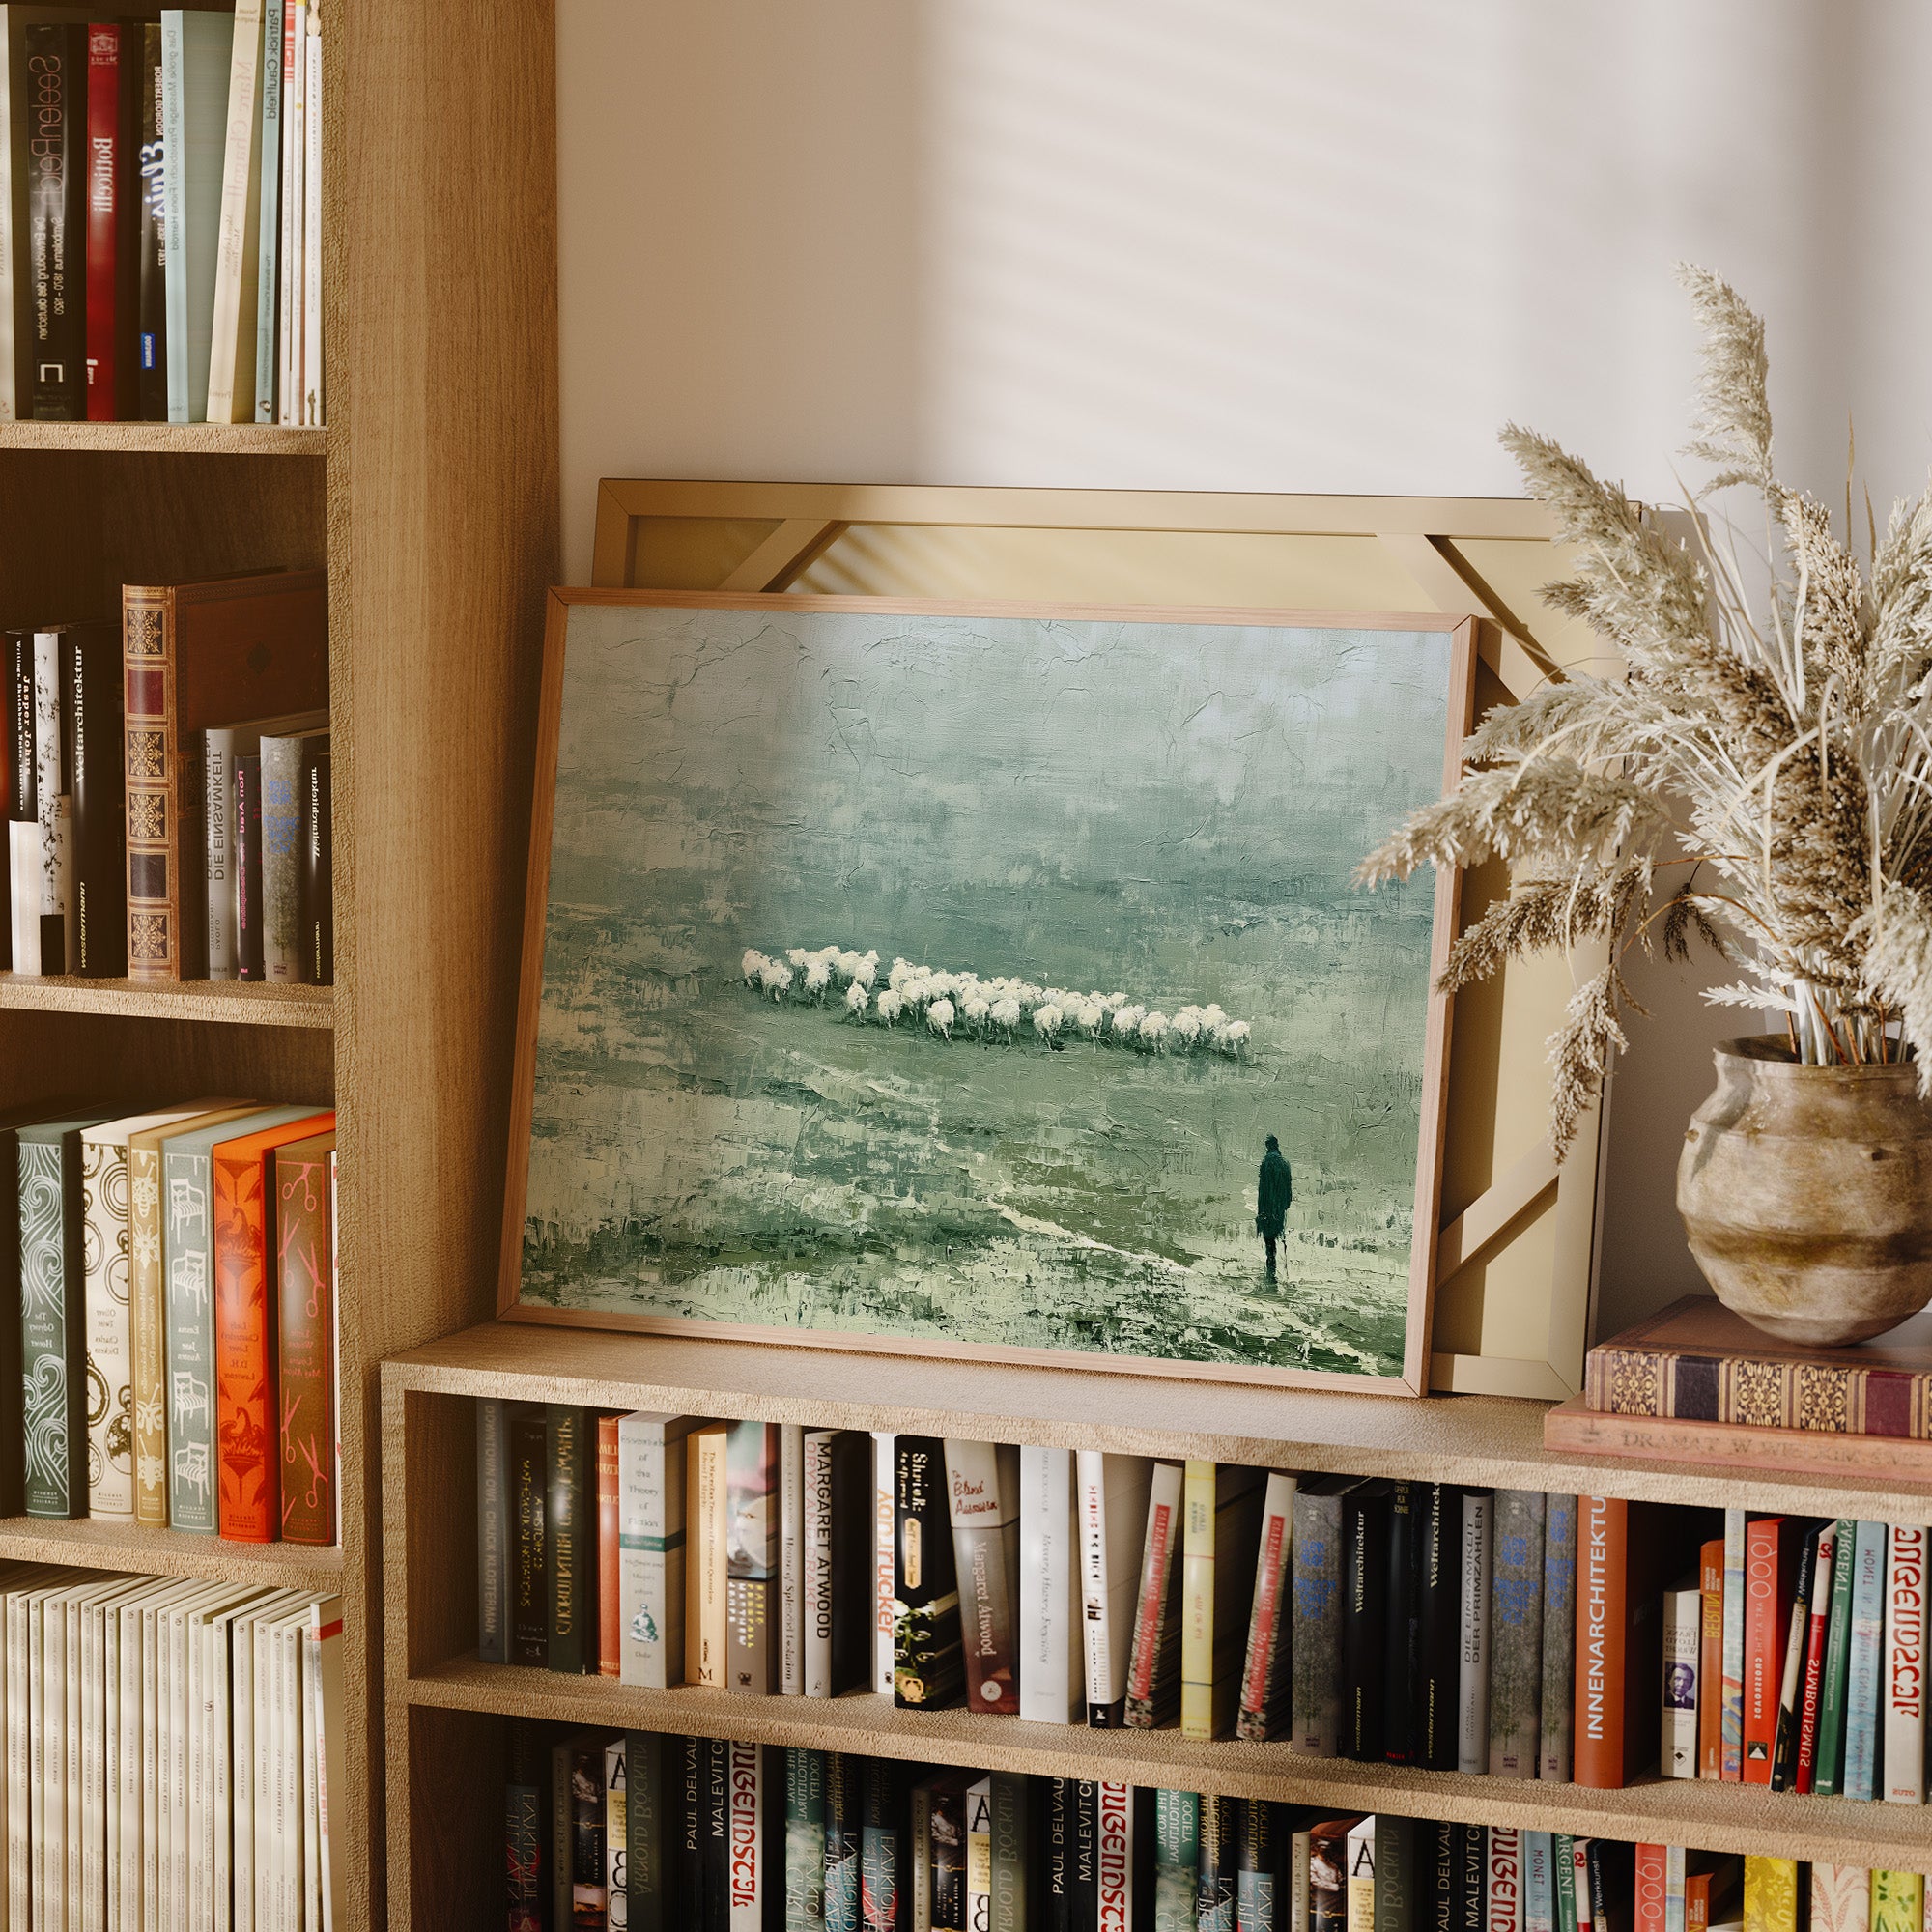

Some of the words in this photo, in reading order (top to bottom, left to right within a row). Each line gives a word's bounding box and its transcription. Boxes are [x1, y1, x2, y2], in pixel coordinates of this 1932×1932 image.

[22, 675, 32, 726] Jasper
[75, 646, 85, 784] Weltarchitektur
[23, 730, 33, 776] Johns
[485, 1406, 496, 1476] DOWNTOWN
[806, 1441, 816, 1492] ORYX
[1622, 1433, 1719, 1451] DRAMAT
[1734, 1439, 1752, 1453] W
[485, 1478, 496, 1504] OWL
[629, 1486, 659, 1497] Theory
[816, 1442, 831, 1551] MARGARET
[911, 1452, 929, 1512] Shriek:
[953, 1481, 983, 1495] Blind
[485, 1511, 496, 1550] CHUCK
[628, 1519, 659, 1529] Fiction
[806, 1497, 816, 1539] AND
[1430, 1482, 1441, 1588] Weltarchitekt
[806, 1546, 817, 1612] CRAKE
[973, 1540, 991, 1600] Margaret
[1355, 1511, 1366, 1613] Weltarchitektur
[1464, 1520, 1474, 1629] EINSAMKEIT
[1472, 1505, 1483, 1621] PRIMZAHLEN
[485, 1555, 496, 1633] KLOSTERMAN
[816, 1557, 831, 1639] ATWOOD
[1587, 1495, 1607, 1740] INNENARCHITEKTU
[978, 1605, 997, 1656] Atwood
[1472, 1627, 1482, 1663] DER
[1427, 1678, 1435, 1759] westermann
[685, 1736, 697, 1803] DELVAU
[685, 1811, 697, 1851] PAUL
[732, 1741, 756, 1908] JUGENDSTIL
[1051, 1776, 1065, 1847] DELVAU
[1050, 1856, 1064, 1895] PAUL
[1438, 1821, 1451, 1889] DELVAU
[1533, 1850, 1544, 1886] MONET
[1558, 1834, 1573, 1898] ARGENT
[1592, 1861, 1603, 1907] Werkkunst
[1535, 1891, 1545, 1902] IN
[1636, 1857, 1662, 1918] 1900
